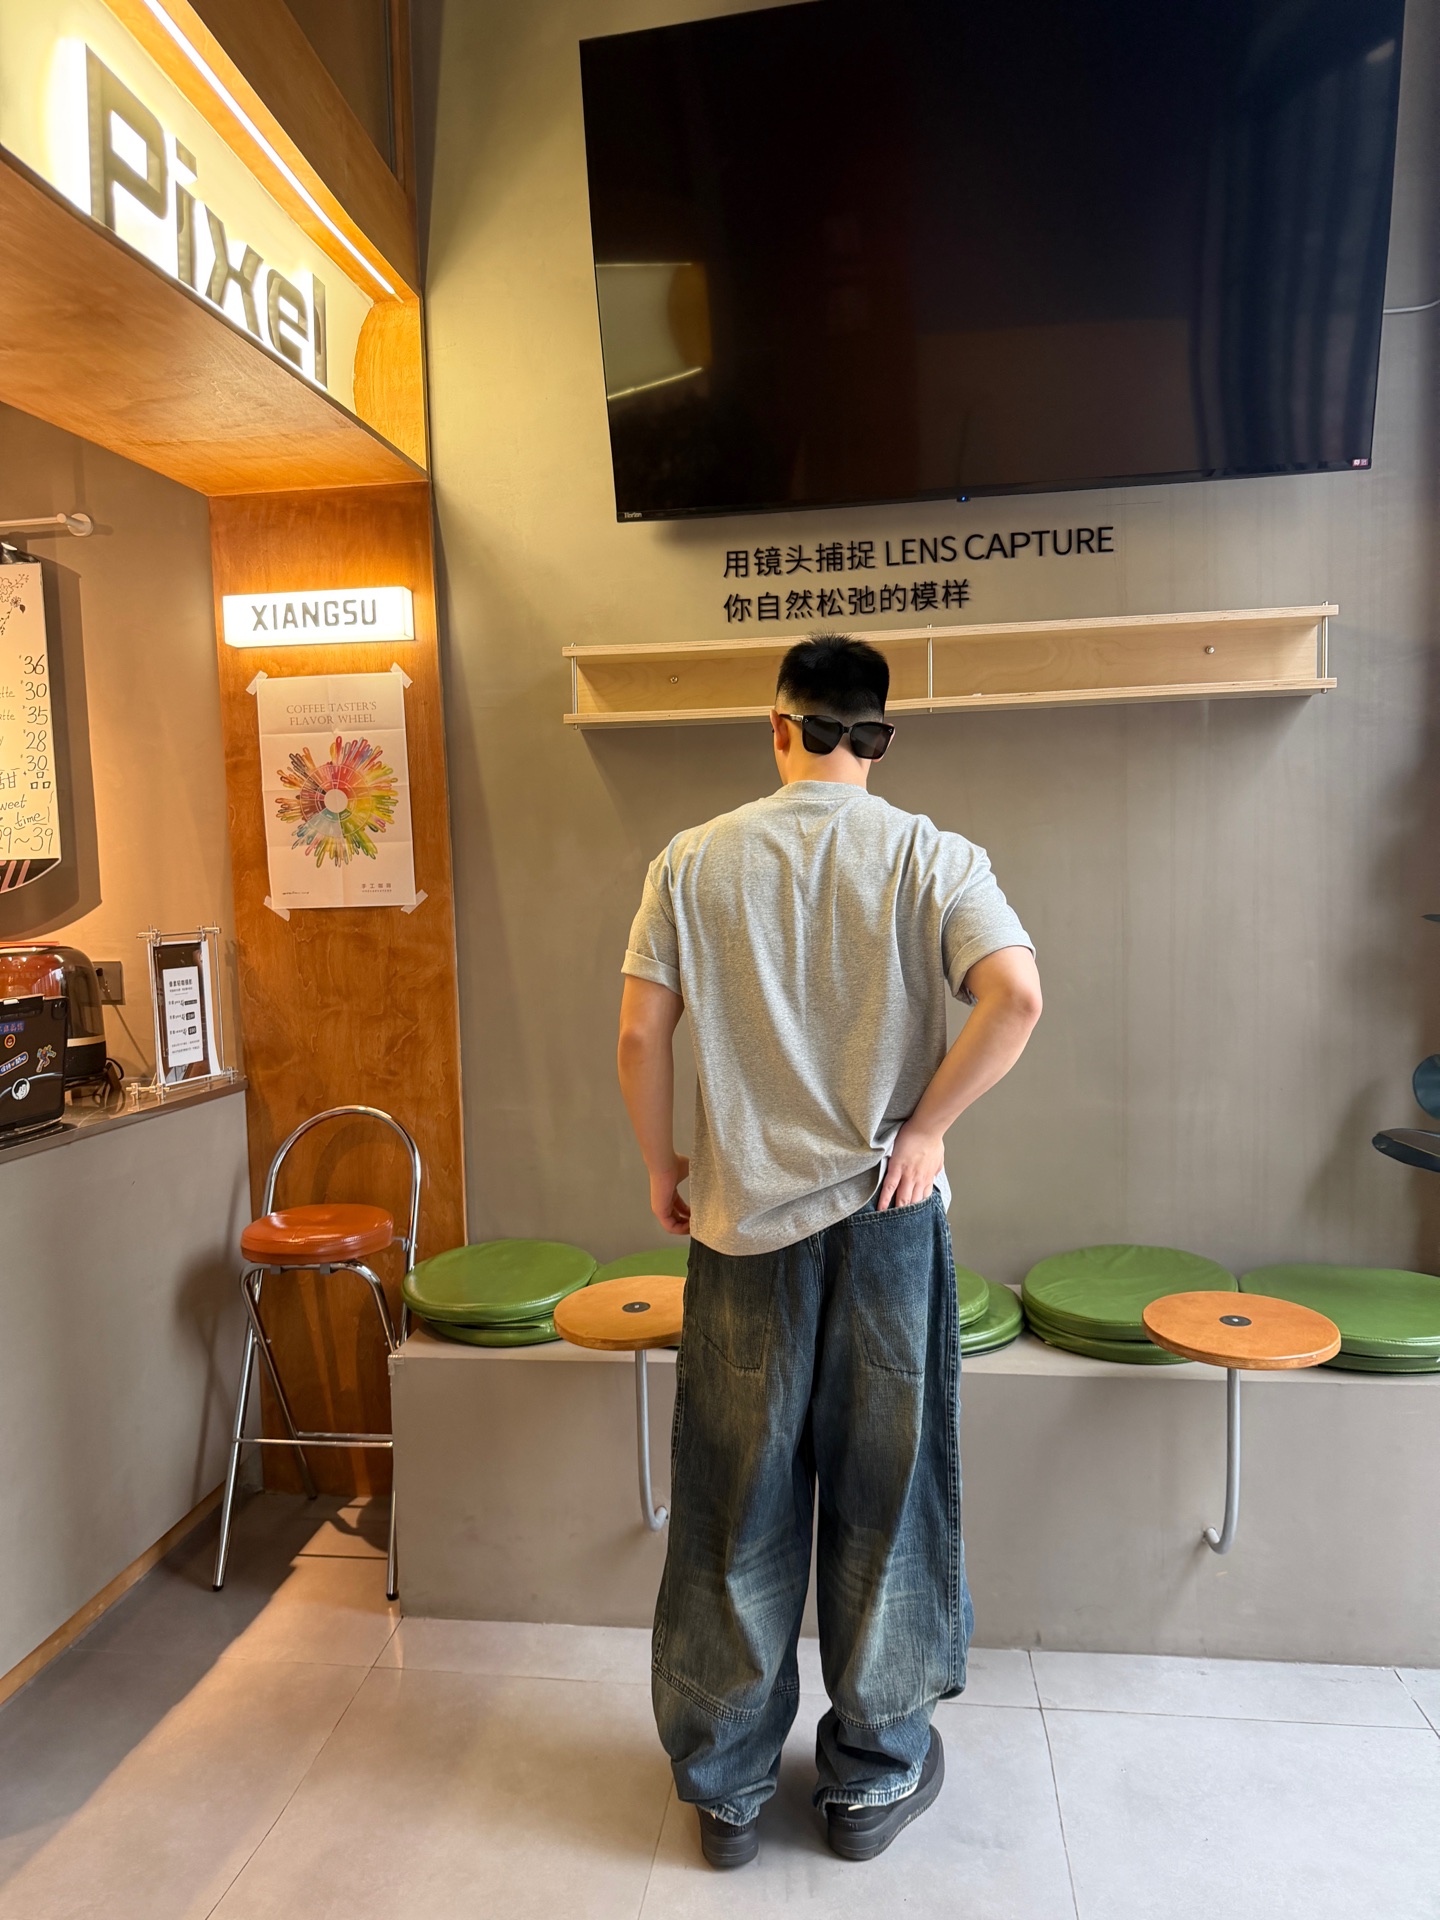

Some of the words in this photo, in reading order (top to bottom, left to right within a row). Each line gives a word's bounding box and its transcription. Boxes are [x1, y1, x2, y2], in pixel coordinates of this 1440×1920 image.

[85, 43, 328, 391] Pixel
[722, 540, 877, 579] 用镜头捕捉
[884, 535, 958, 567] LENS
[964, 526, 1114, 561] CAPTURE
[251, 599, 377, 632] XIANGSU
[722, 579, 971, 623] 你自然松弛的模样
[286, 703, 326, 714] COFFEE
[328, 701, 377, 712] TASTER'S
[289, 715, 334, 726] FLAVOR
[338, 713, 376, 724] WHEEL
